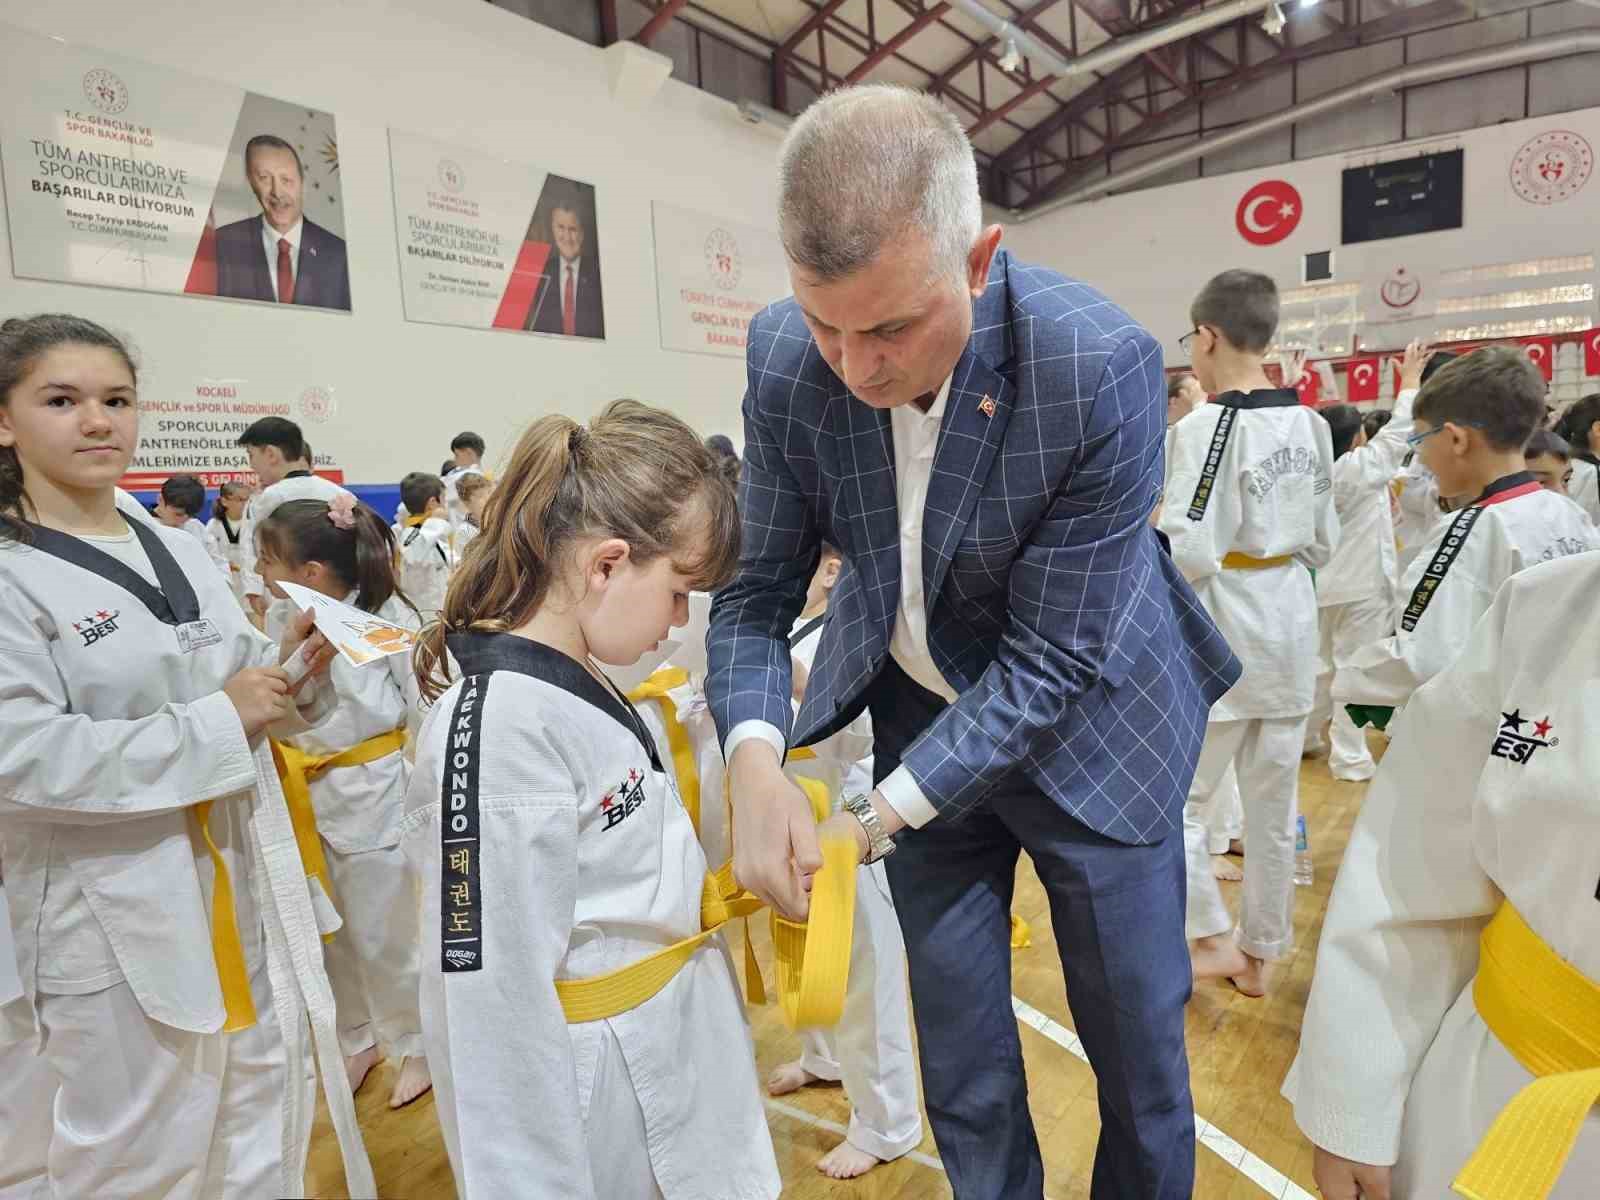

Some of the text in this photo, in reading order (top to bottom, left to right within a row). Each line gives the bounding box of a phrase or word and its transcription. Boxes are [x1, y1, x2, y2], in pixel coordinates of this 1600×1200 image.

[66, 121, 95, 136] SPOR
[139, 127, 152, 137] VE
[31, 139, 189, 185] TÜM ANTRENÖR VE
[39, 160, 185, 200] SPORCULARIMIZA
[31, 179, 195, 218] BAŞARILAR DİLİYORUM
[196, 385, 238, 398] KOCAELİ
[196, 402, 221, 413] SPOR
[214, 455, 250, 469] BAŞA
[451, 674, 481, 833] TAEKWONDO
[448, 848, 472, 932] 태권도
